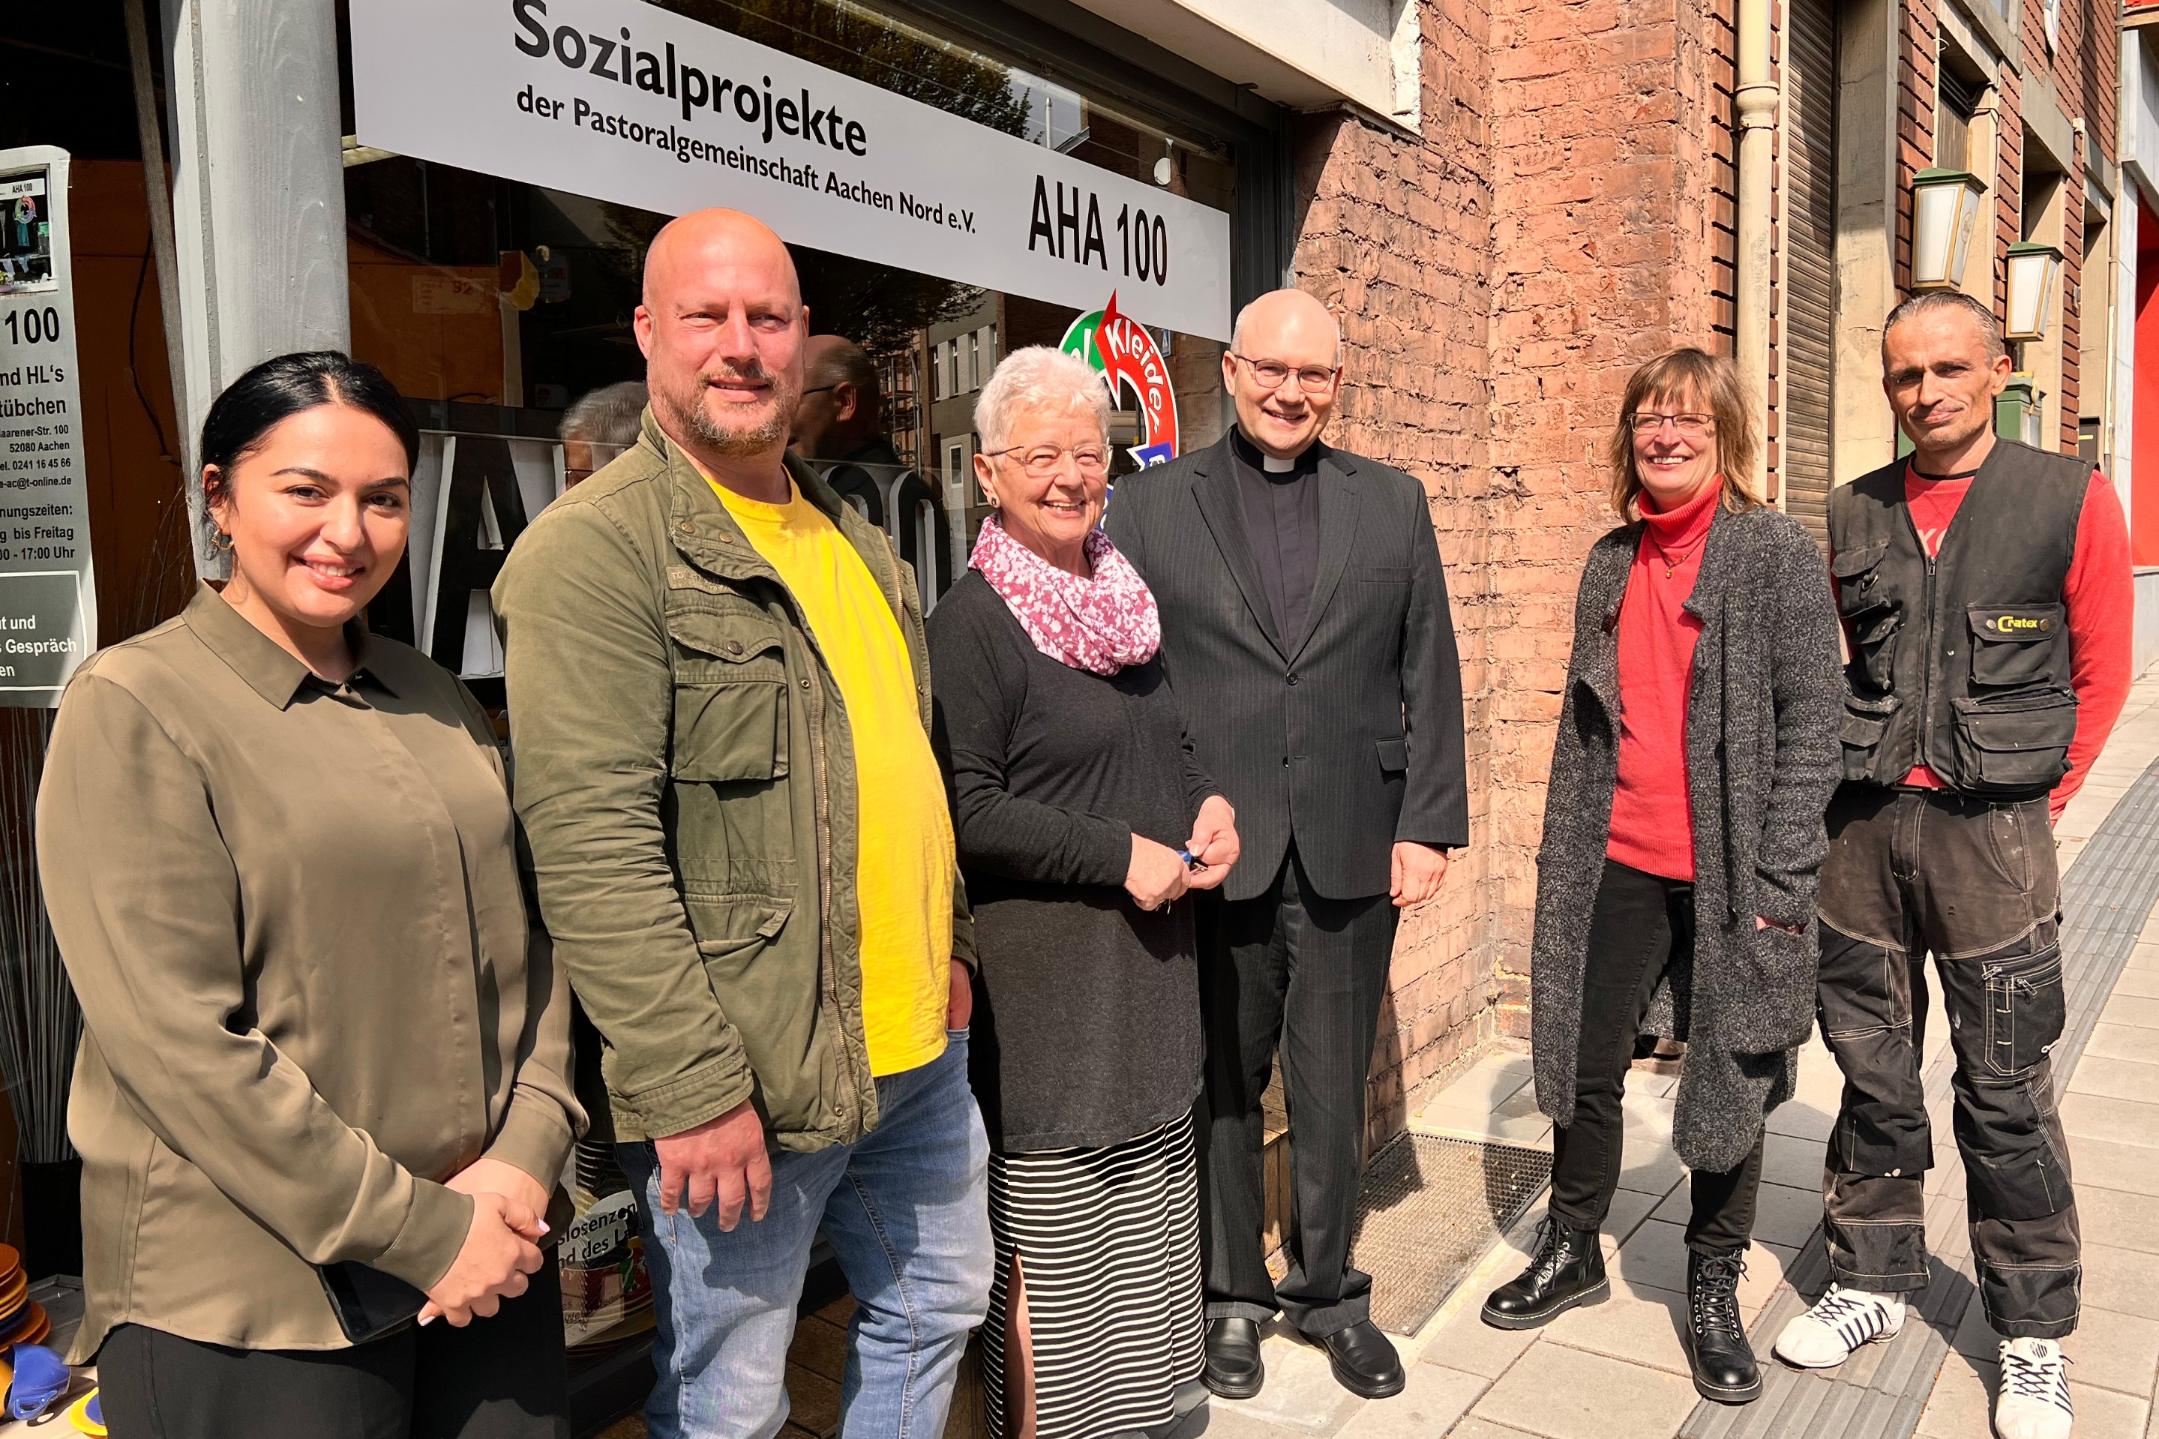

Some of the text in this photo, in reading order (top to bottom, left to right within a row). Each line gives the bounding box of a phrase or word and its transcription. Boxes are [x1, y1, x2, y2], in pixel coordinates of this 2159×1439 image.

[513, 0, 867, 156] Sozialprojekte
[516, 84, 976, 234] der Pastoralgemeinschaft Aachen Nord e.V.
[12, 182, 33, 193] AHA 100
[1028, 174, 1168, 287] AHA 100
[5, 307, 60, 345] 100
[1104, 318, 1164, 434] Kleider
[54, 425, 69, 435] 100
[9, 440, 70, 453] 52080 Aachen
[12, 460, 33, 471] 0241
[36, 459, 46, 470] 16
[48, 458, 59, 469] 45
[61, 457, 71, 468] 66
[14, 527, 31, 540] bis
[34, 526, 74, 541] Freitag
[21, 547, 50, 560] 17:00
[53, 546, 75, 559] Uhr
[10, 615, 36, 630] und
[6, 637, 77, 656] Gespräch
[581, 1237, 609, 1260] des
